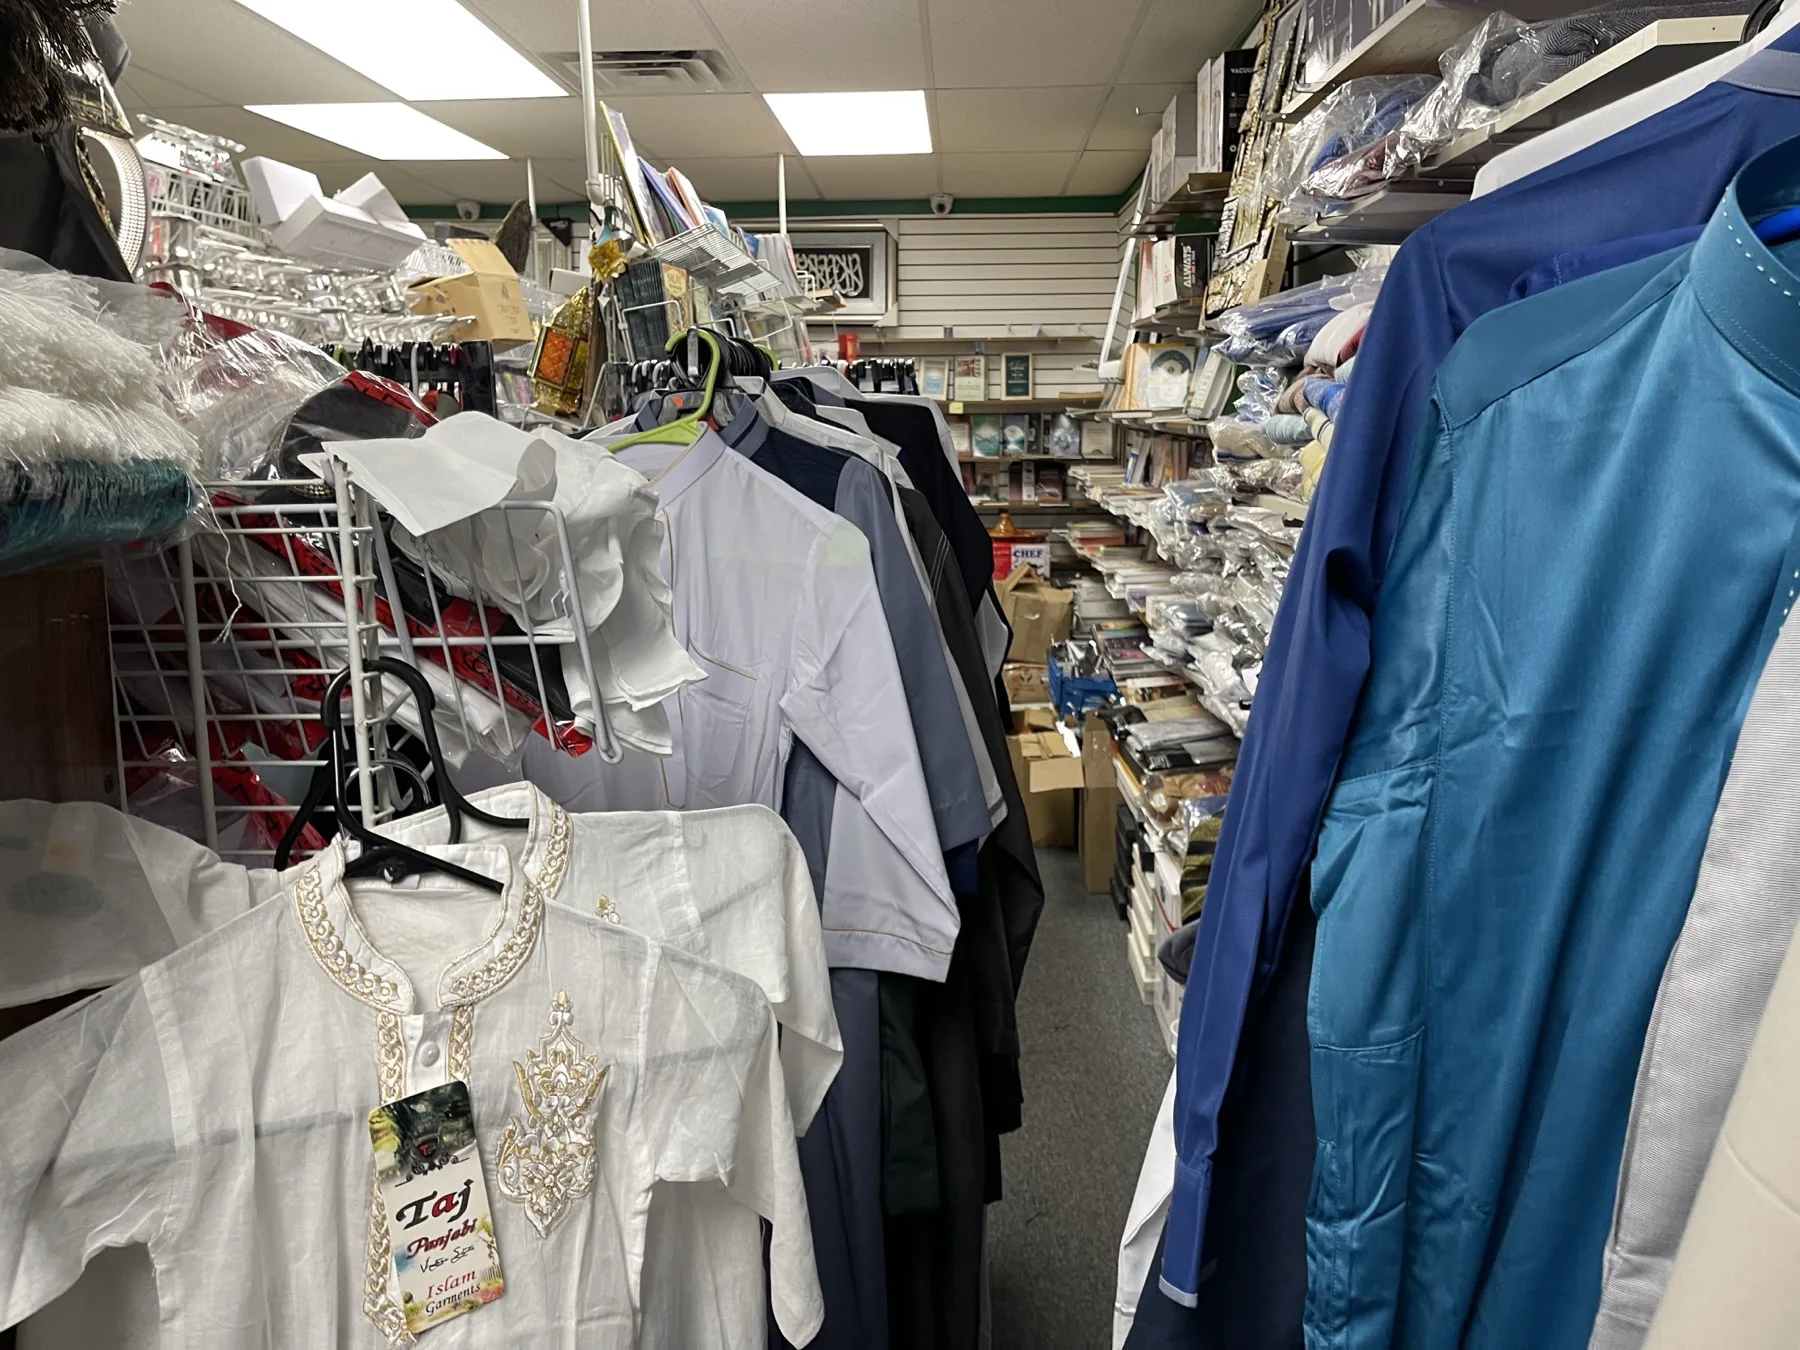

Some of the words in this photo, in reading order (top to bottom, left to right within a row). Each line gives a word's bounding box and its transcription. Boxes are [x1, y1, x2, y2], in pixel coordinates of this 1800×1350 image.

[1013, 549, 1043, 558] CHEF
[396, 1178, 474, 1230] Taj
[426, 1284, 480, 1316] Garments
[427, 1271, 476, 1299] Islam
